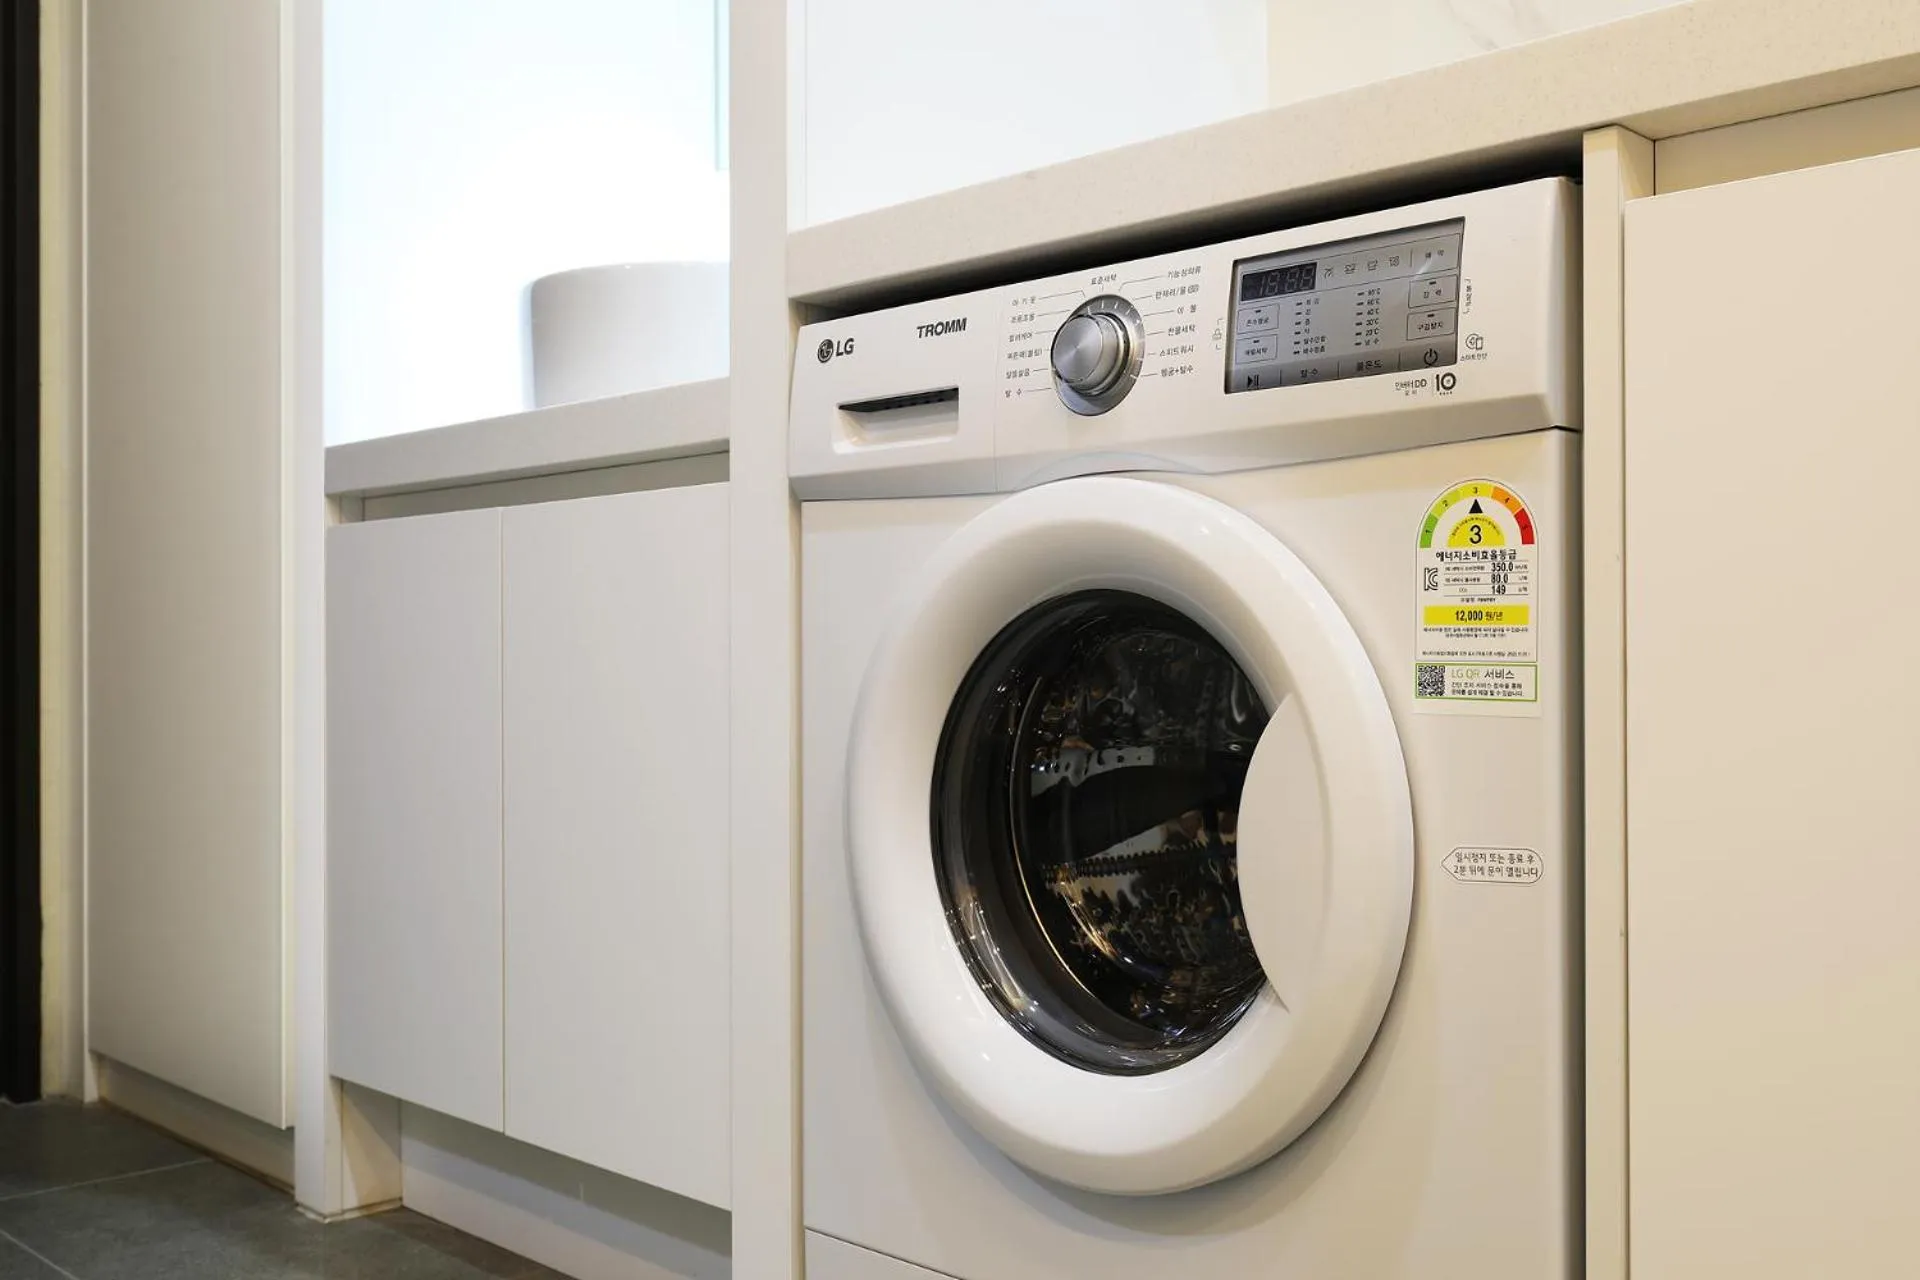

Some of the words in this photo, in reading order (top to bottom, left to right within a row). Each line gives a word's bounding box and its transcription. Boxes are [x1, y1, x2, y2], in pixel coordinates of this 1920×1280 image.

[917, 317, 968, 339] TROMM
[835, 337, 855, 357] LG
[1435, 372, 1457, 392] 10
[1469, 524, 1482, 544] 3
[1436, 549, 1517, 562] 에너지소비효율등급
[1491, 562, 1514, 573] 350.0
[1491, 573, 1509, 584] 80.0
[1491, 584, 1506, 595] 149
[1455, 610, 1483, 622] 12,000
[1451, 669, 1463, 679] LG
[1484, 668, 1515, 679] 서비스
[1455, 851, 1487, 863] 일시정지
[1489, 853, 1505, 865] 또는
[1507, 853, 1523, 865] 종료
[1527, 854, 1536, 864] 후
[1453, 865, 1466, 876] 2분
[1469, 865, 1485, 876] 뒤에
[1488, 865, 1504, 877] 문이
[1506, 866, 1538, 878] 열립니다
